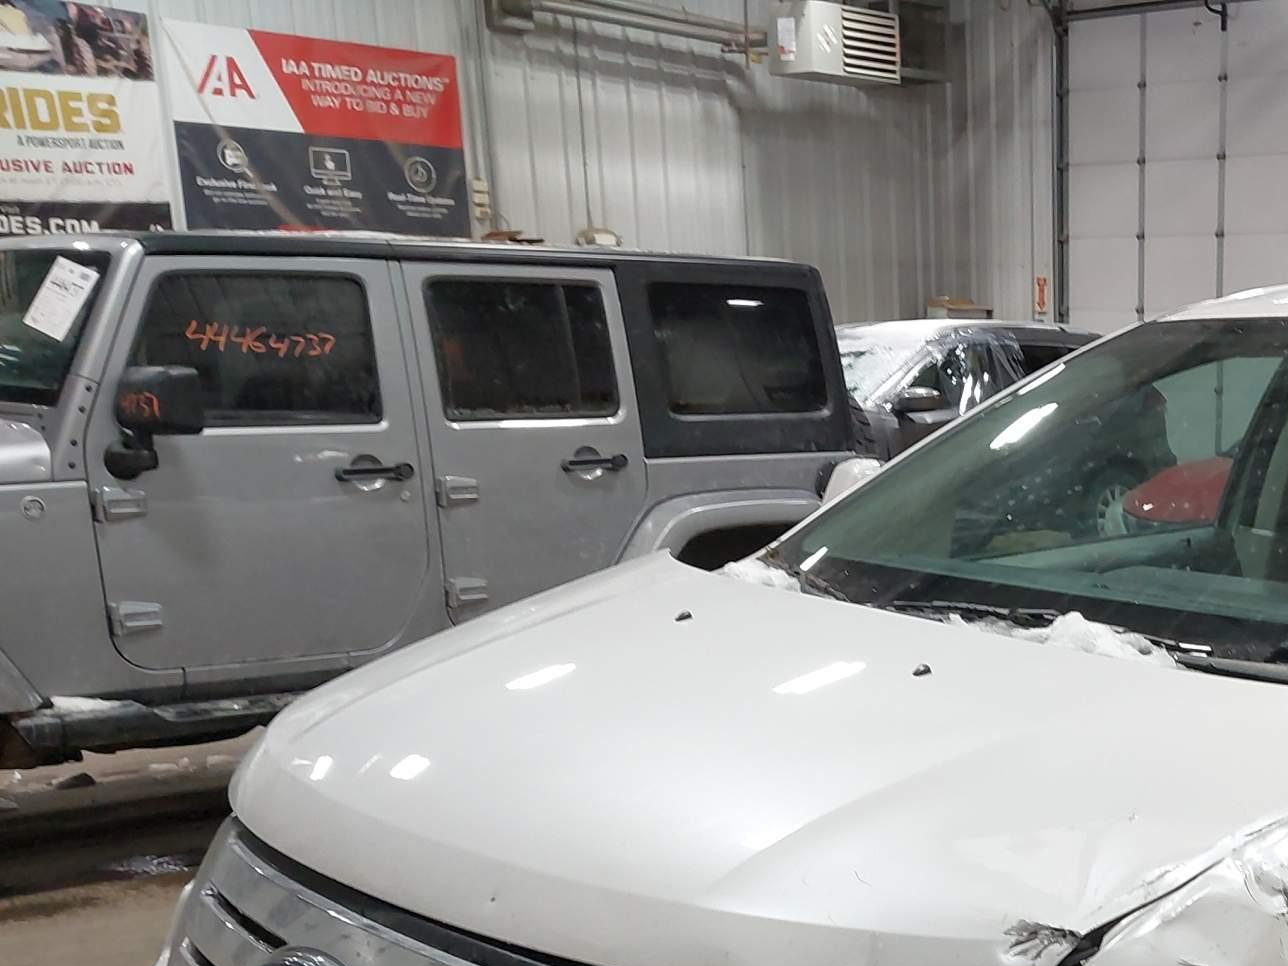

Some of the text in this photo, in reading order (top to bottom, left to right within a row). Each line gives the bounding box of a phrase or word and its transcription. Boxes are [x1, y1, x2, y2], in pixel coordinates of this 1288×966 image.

[281, 57, 310, 77] IAA
[311, 62, 362, 82] TIMED
[301, 78, 437, 105] INTRODUCING A NEW
[311, 94, 341, 109] WAY
[345, 97, 364, 112] TO
[389, 102, 399, 115] &
[402, 104, 430, 119] BUY
[62, 161, 134, 176] AUCTION
[184, 319, 336, 358] 44464737
